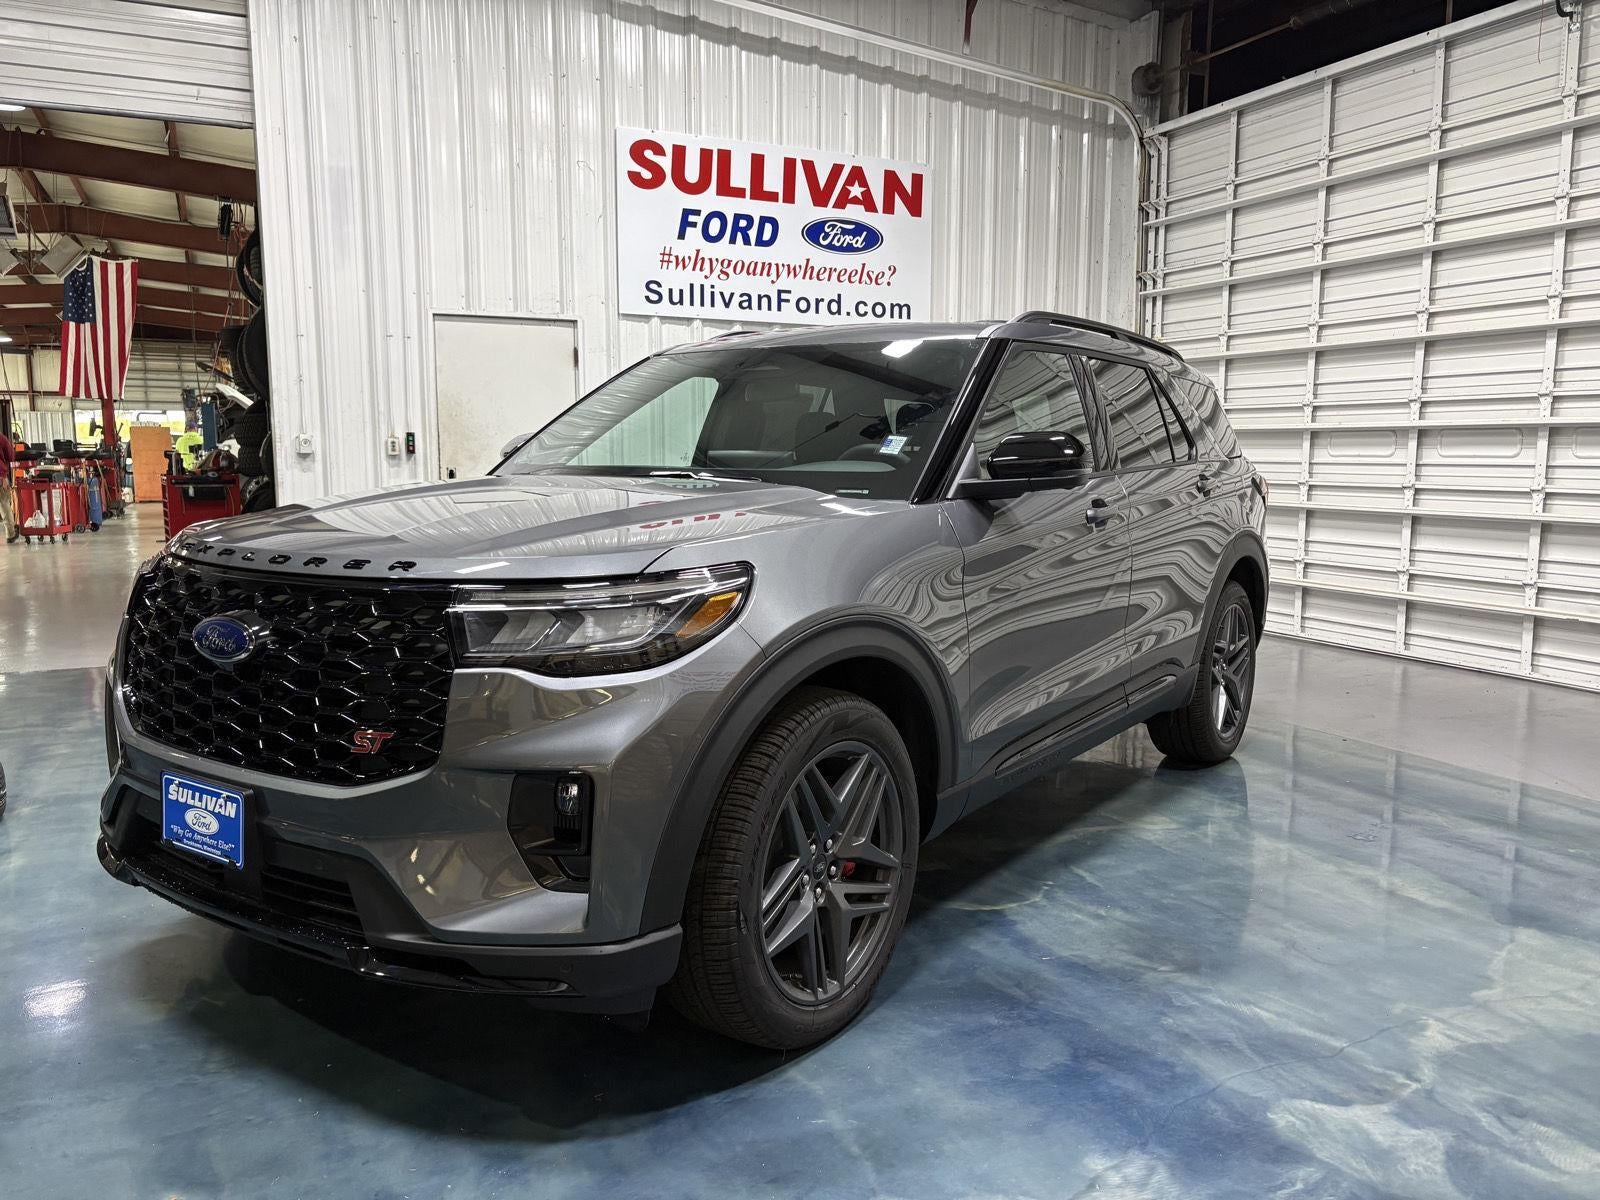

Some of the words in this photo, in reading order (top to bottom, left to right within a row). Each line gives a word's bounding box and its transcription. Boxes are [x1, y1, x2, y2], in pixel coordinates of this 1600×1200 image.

[627, 138, 923, 218] SULLIVAN
[677, 208, 780, 248] FORD
[819, 221, 866, 249] Ford
[659, 245, 897, 287] #whygoanywhereelse?
[644, 280, 912, 320] SullivanFord.com
[181, 542, 417, 572] EXPLORER
[201, 624, 236, 651] Ford
[351, 731, 394, 754] ST
[168, 784, 237, 819] SULLIVAN
[184, 829, 193, 838] Go
[191, 812, 212, 831] Ford
